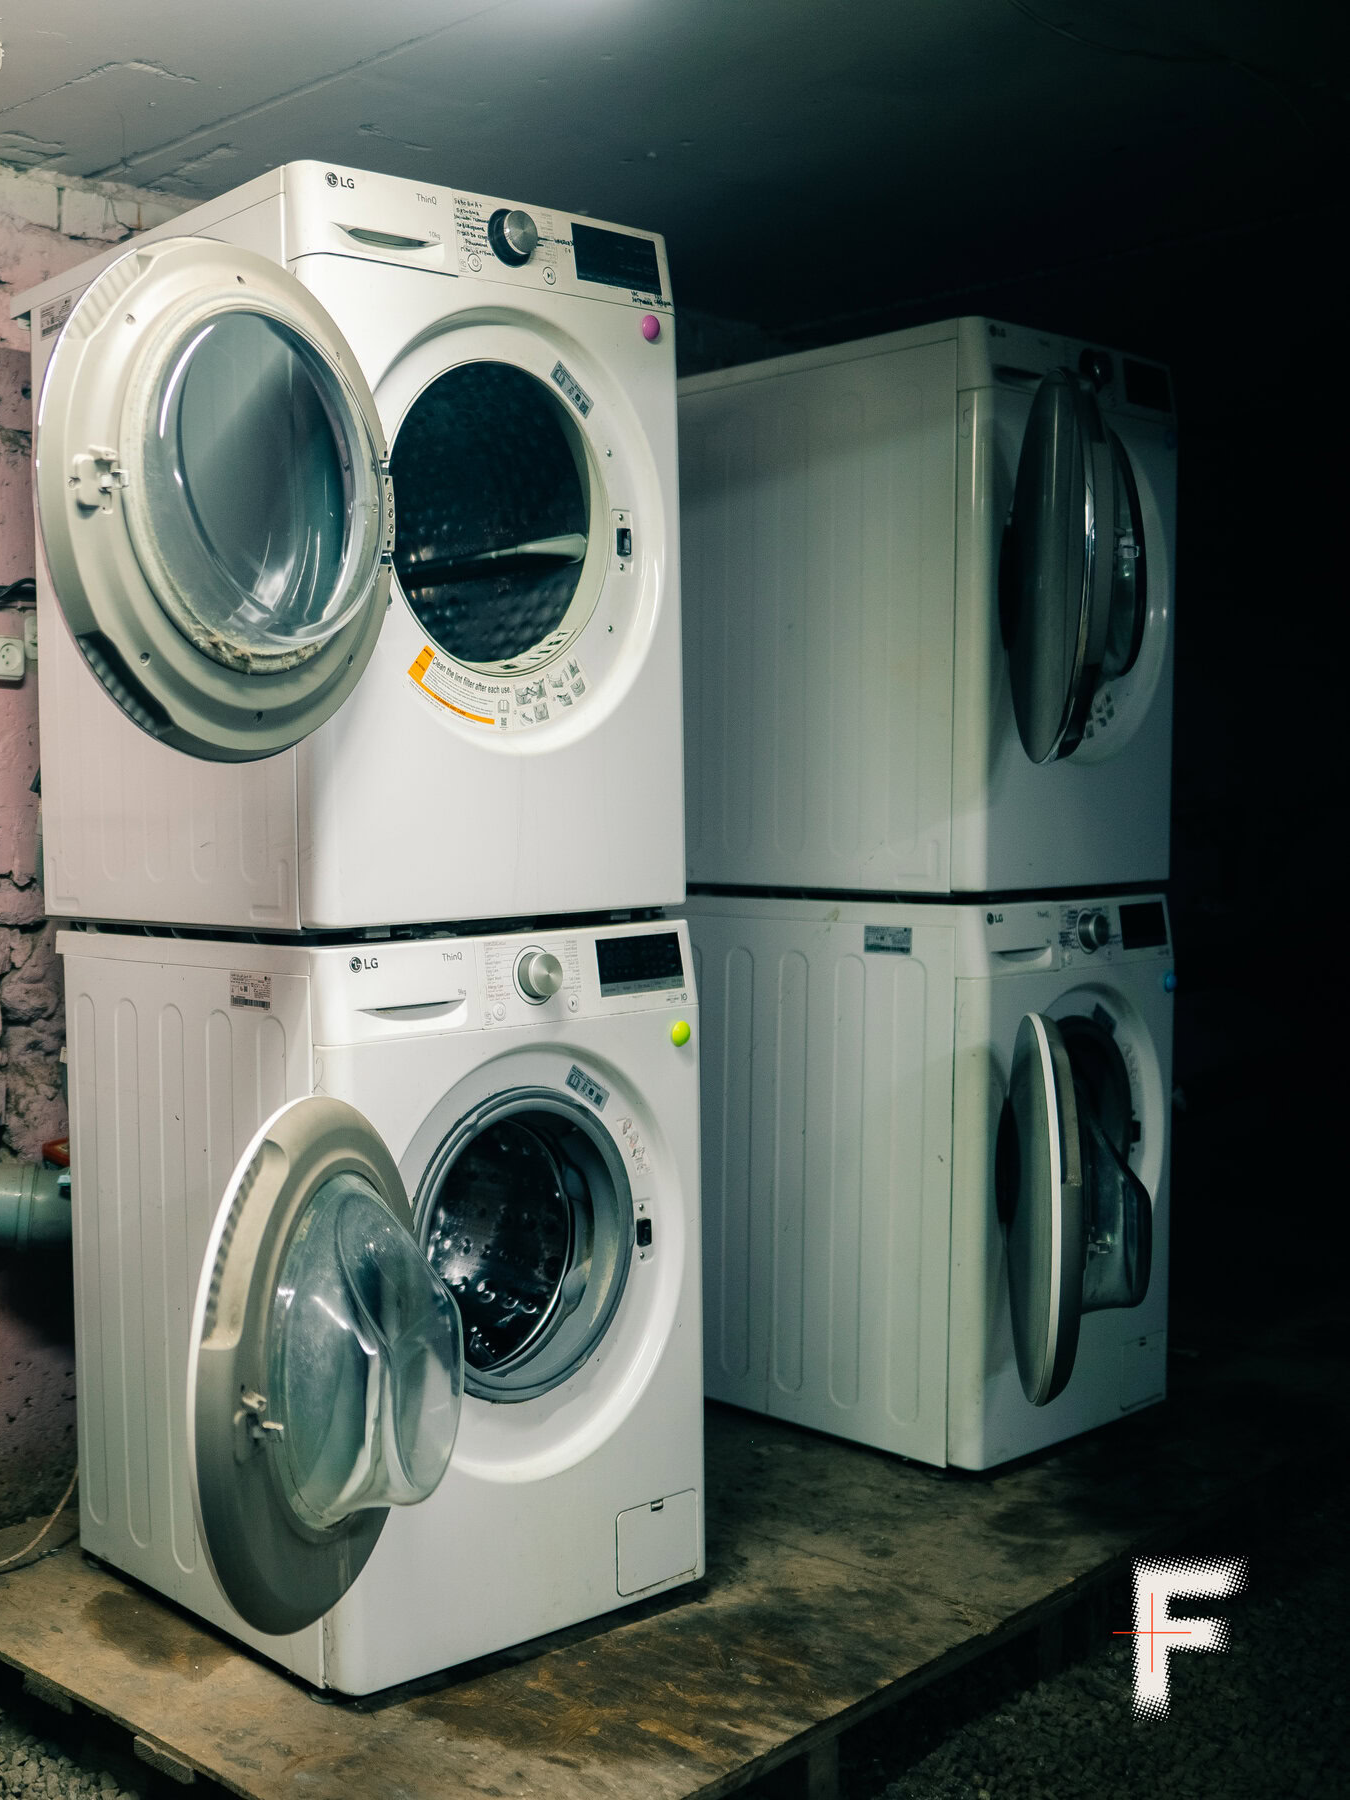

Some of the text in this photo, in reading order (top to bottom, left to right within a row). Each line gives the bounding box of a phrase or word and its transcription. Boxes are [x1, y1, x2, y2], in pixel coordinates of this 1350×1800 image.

[340, 176, 355, 189] LG
[416, 193, 438, 205] ThinQ
[432, 656, 447, 673] Clean
[445, 667, 455, 678] the
[454, 672, 463, 684] lint
[463, 676, 475, 688] filter
[475, 682, 487, 692] after
[487, 685, 500, 694] each
[500, 686, 511, 694] use.
[364, 957, 378, 969] LG
[442, 952, 463, 962] ThinQ
